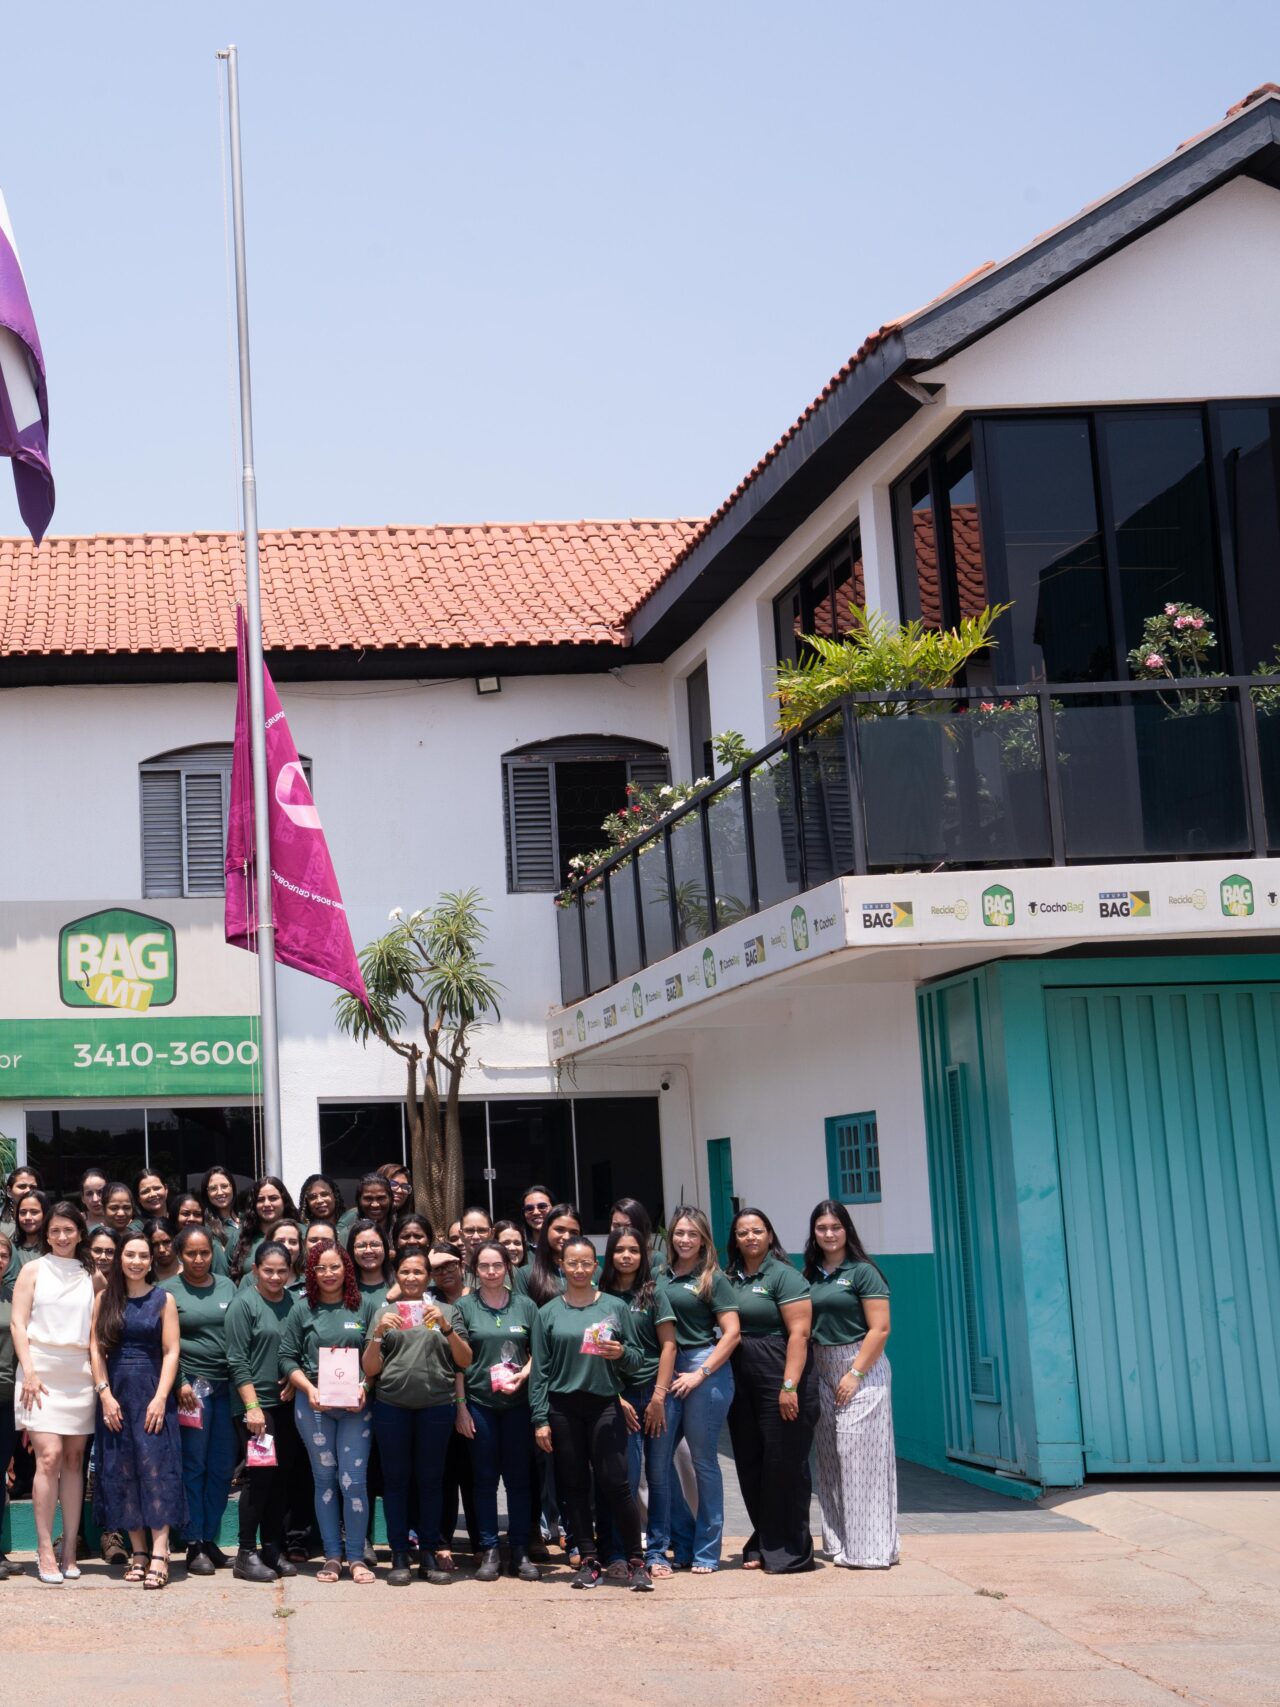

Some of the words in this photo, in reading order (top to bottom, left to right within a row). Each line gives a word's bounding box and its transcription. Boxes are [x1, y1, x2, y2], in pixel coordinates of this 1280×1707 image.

[311, 893, 332, 906] ROSA
[1222, 885, 1252, 905] BAG
[983, 894, 1012, 915] BAG
[1040, 901, 1084, 913] CochoBag
[1099, 902, 1131, 918] BAG
[863, 913, 893, 928] BAG
[67, 932, 169, 982] BAG
[745, 950, 758, 968] BAG
[95, 977, 146, 1010] MT
[666, 985, 677, 1002] BAG
[73, 1040, 260, 1068] 3410-3600
